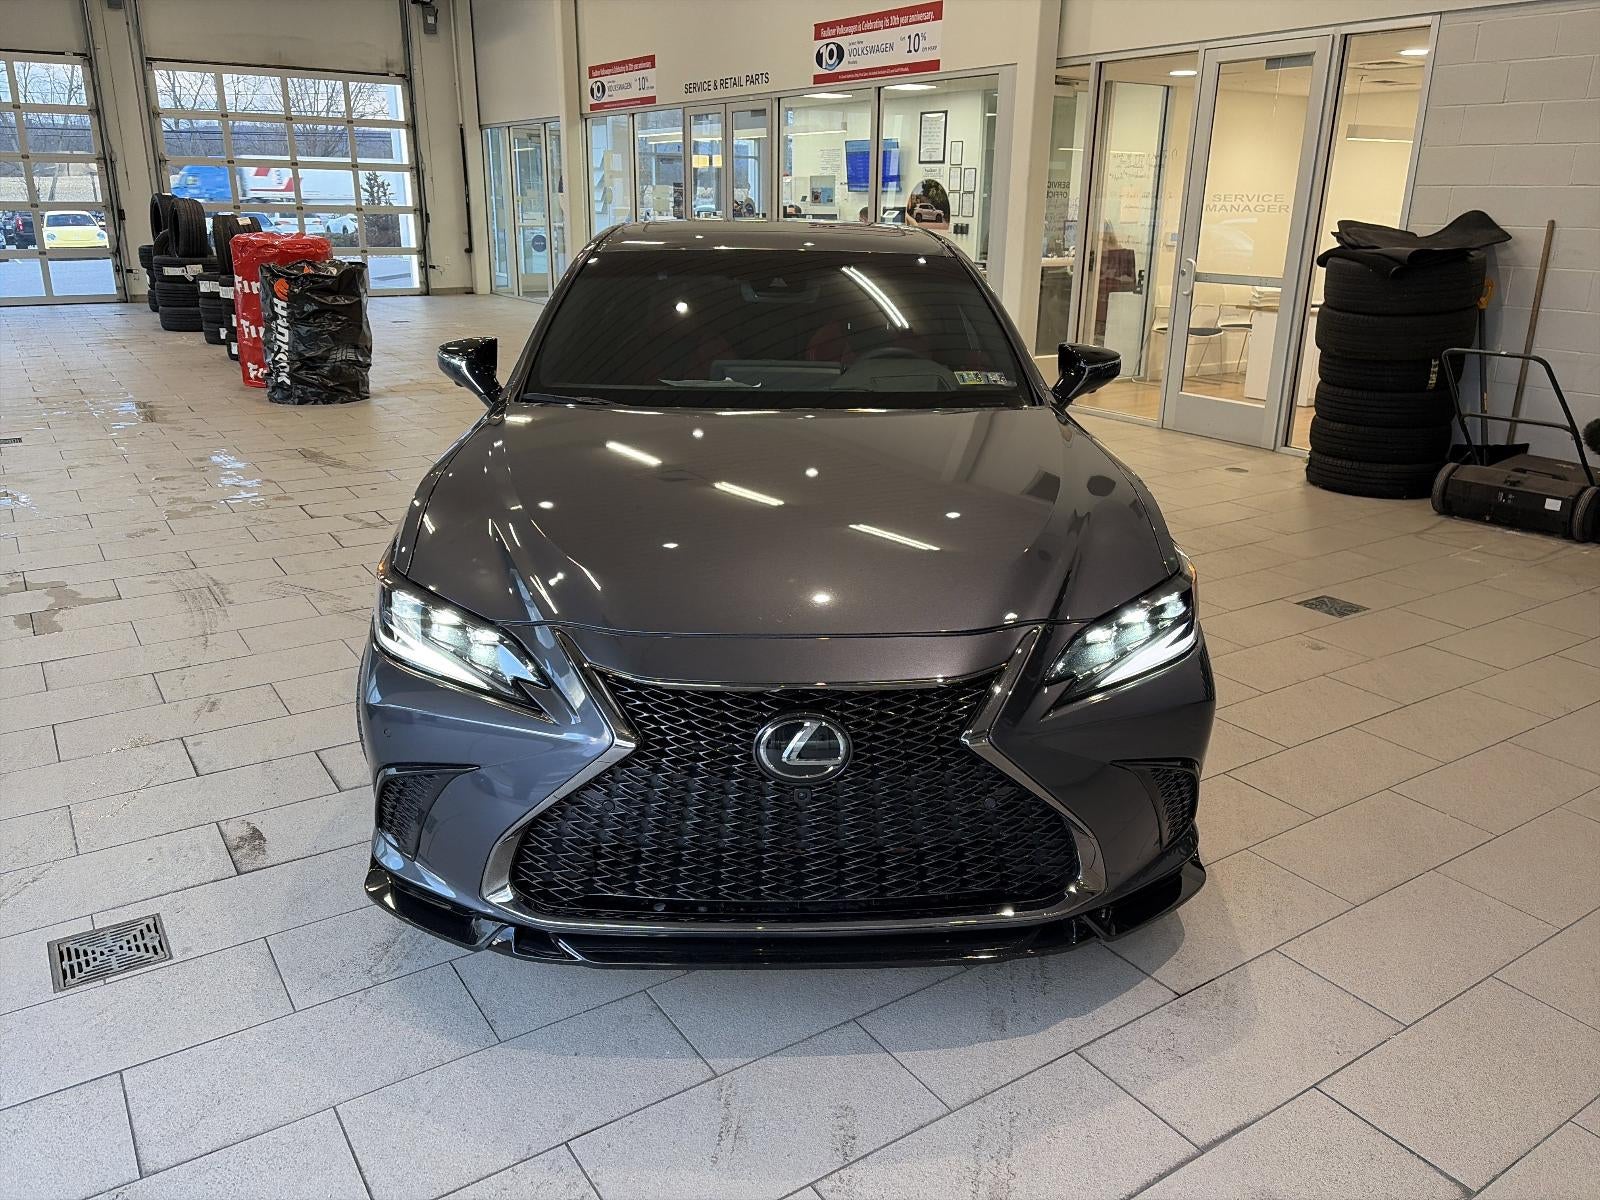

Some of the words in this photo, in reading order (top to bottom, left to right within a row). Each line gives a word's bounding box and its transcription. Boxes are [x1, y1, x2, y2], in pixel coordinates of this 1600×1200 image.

[836, 24, 857, 36] Volkswagen
[862, 18, 884, 30] Celebrating
[890, 14, 899, 26] 10th
[900, 15, 909, 27] year
[909, 10, 934, 23] anniversary.
[820, 44, 838, 69] 10
[848, 42, 894, 58] VOLKSWAGEN
[684, 80, 712, 94] SERVICE
[714, 80, 718, 90] &
[720, 76, 744, 90] RETAIL
[746, 72, 770, 86] PARTS
[1212, 194, 1286, 202] SERVICE
[1206, 204, 1290, 214] MANAGER
